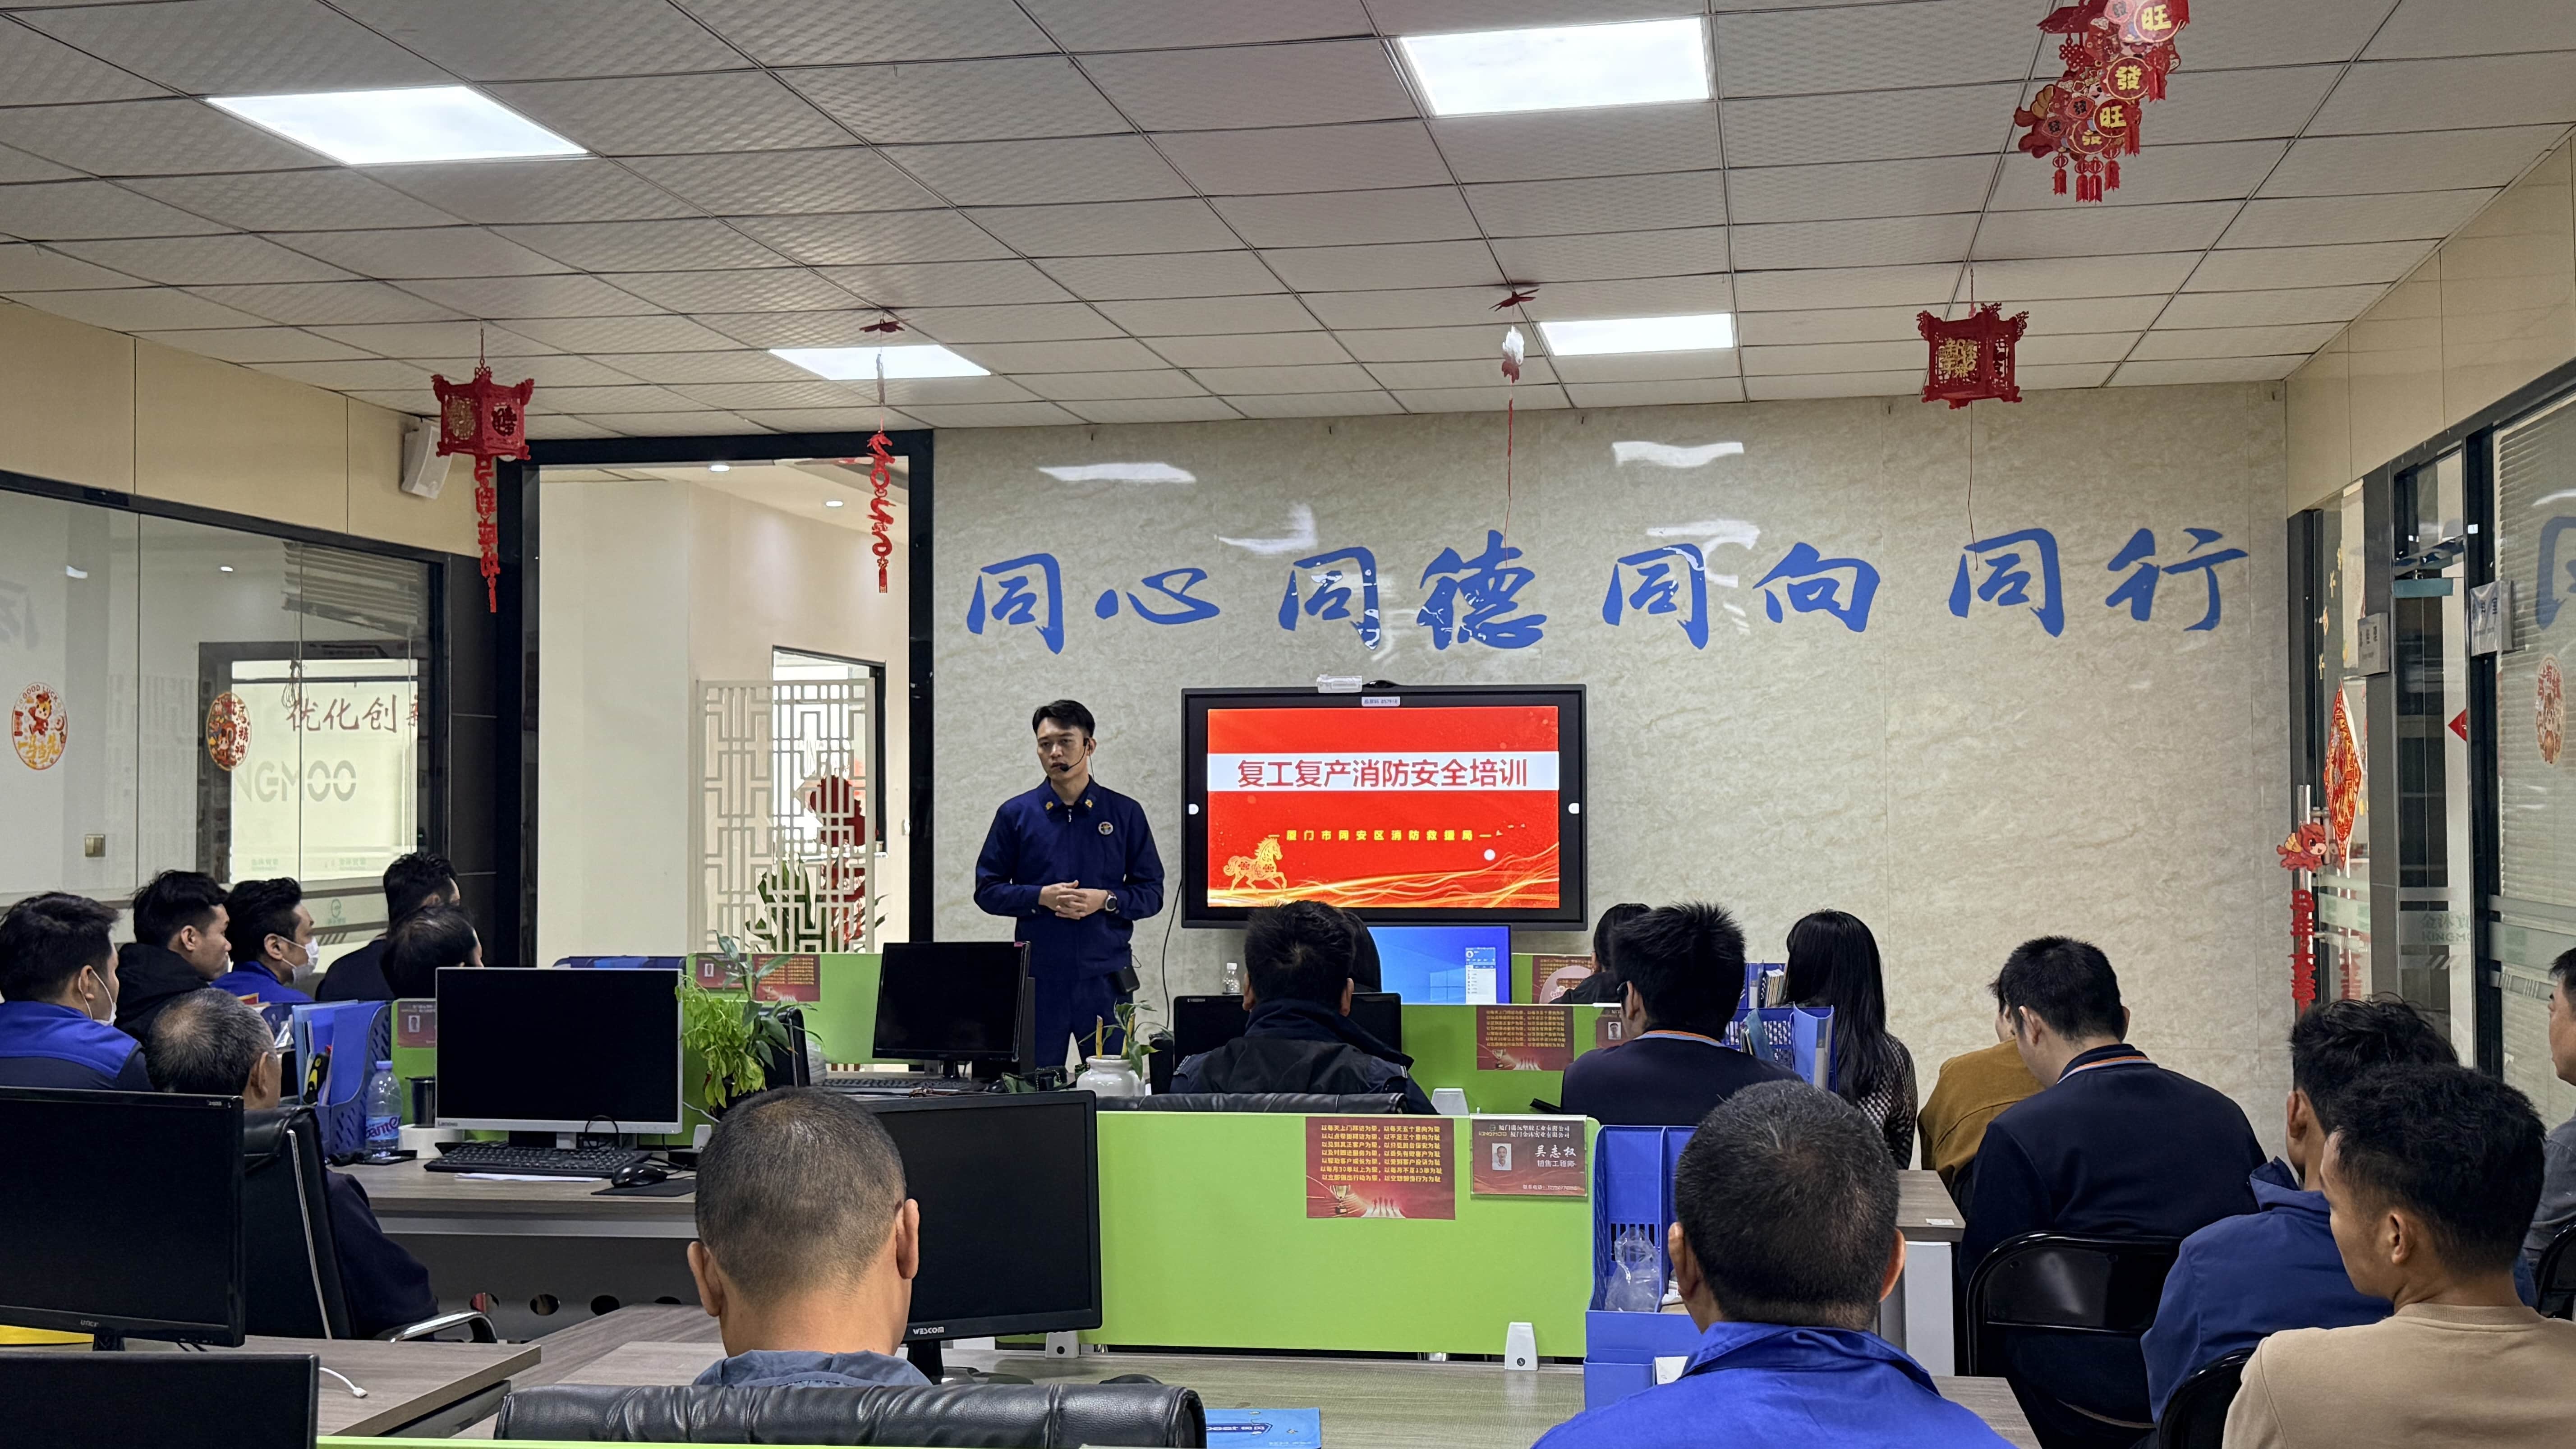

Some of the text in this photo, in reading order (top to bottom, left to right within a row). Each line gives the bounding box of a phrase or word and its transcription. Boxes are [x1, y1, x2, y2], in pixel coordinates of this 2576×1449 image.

[2141, 4, 2172, 31] 旺
[2115, 65, 2142, 91] 發
[2100, 105, 2127, 129] 旺
[23, 685, 58, 703] GOOD LUCK
[1238, 759, 1527, 788] 复工复产消防安全培训
[1286, 829, 1473, 841] 厦门市同安区消防救援局
[1535, 1144, 1577, 1158] 吴志权
